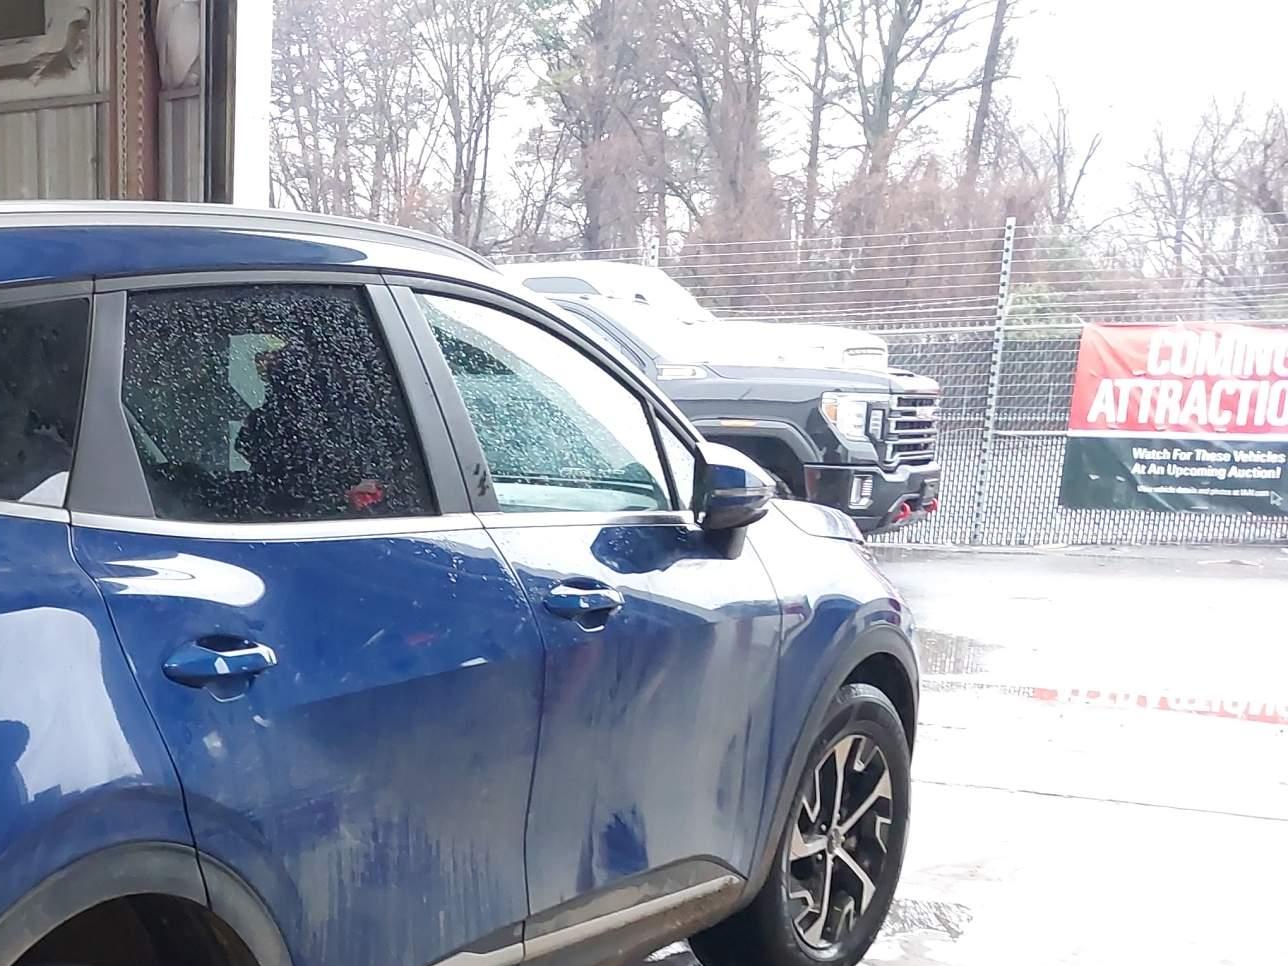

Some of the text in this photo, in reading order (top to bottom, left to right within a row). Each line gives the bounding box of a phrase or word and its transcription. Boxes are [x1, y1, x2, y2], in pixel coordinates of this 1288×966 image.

[1132, 448, 1286, 463] Watch For These Vehicles
[1131, 462, 1281, 480] At An Upcoming Auction!
